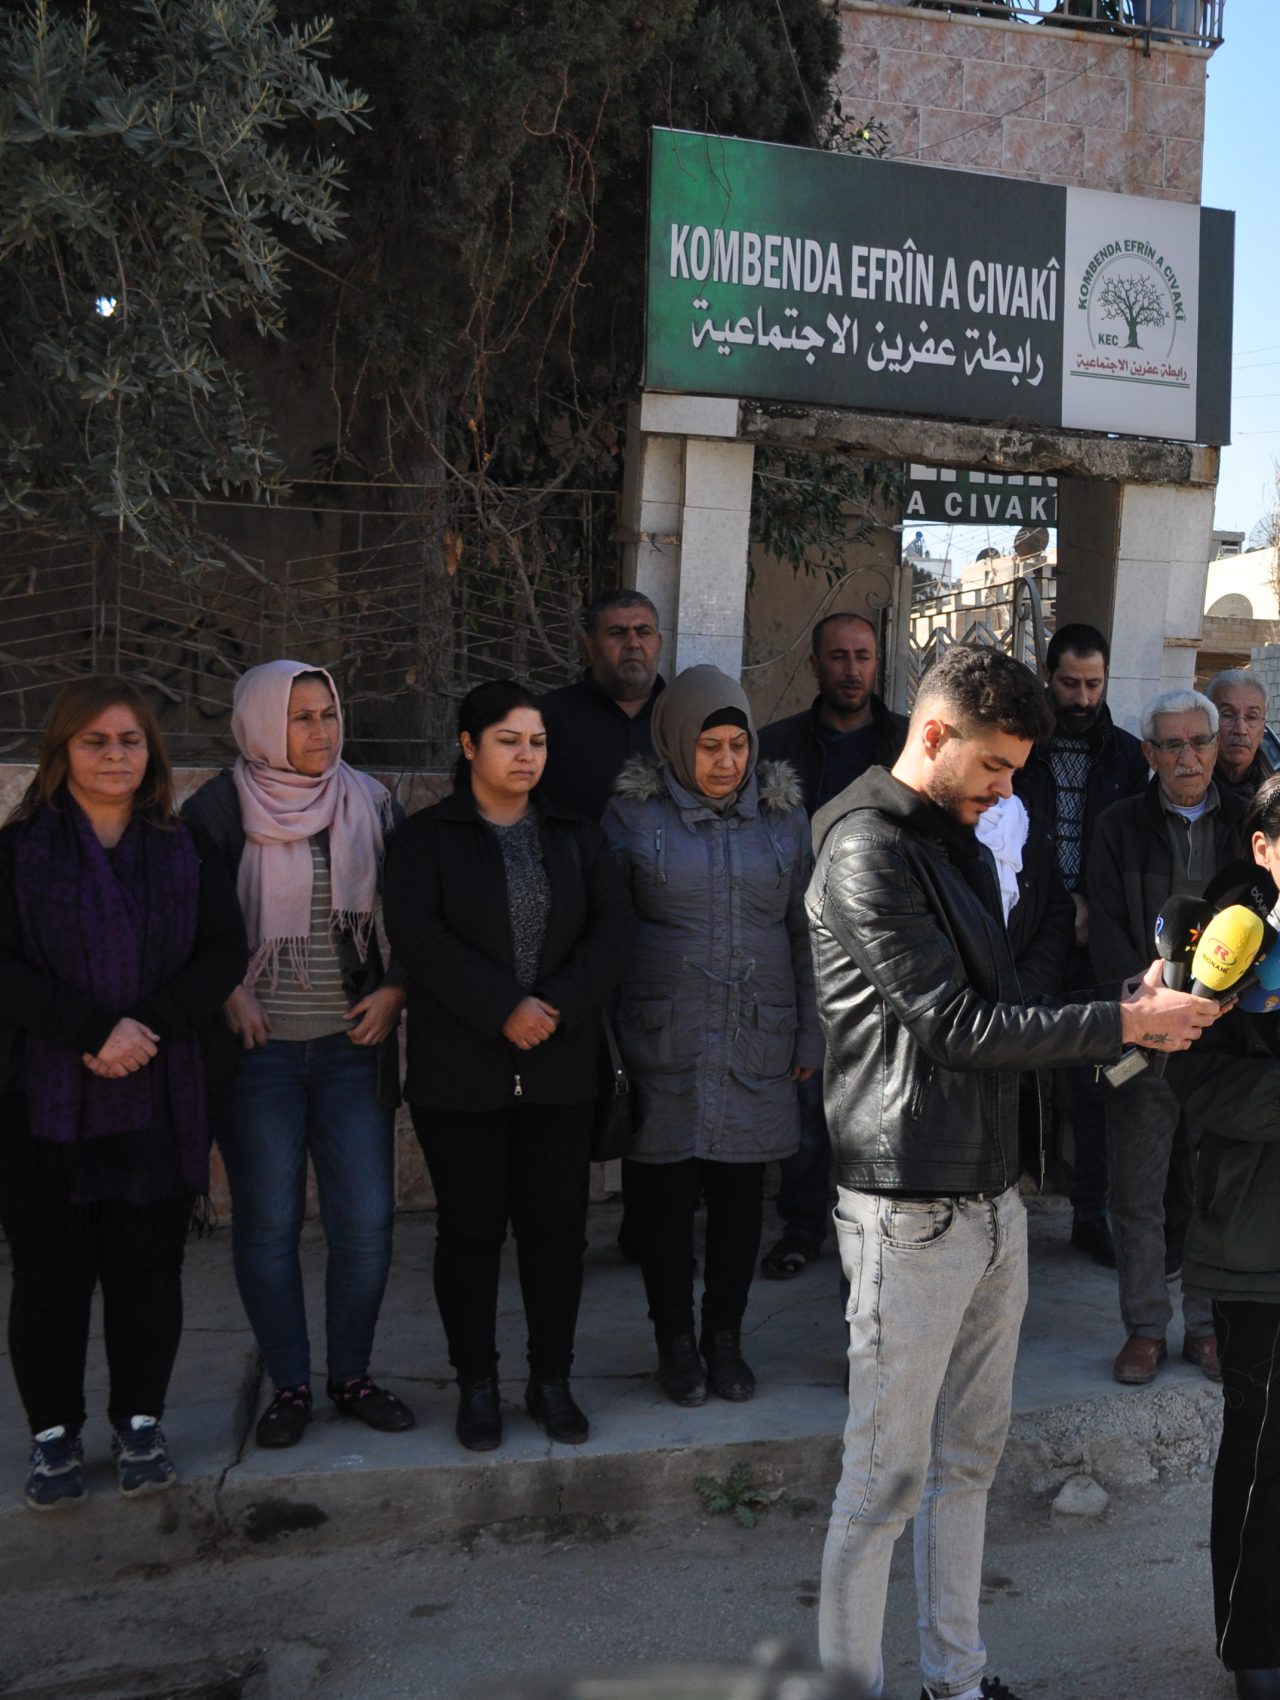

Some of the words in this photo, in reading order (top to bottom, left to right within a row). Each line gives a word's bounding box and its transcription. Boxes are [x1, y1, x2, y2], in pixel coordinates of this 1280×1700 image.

[669, 223, 843, 297] KOMBENDA
[851, 237, 935, 306] EFRÎN
[940, 258, 960, 311] A
[967, 256, 1060, 322] CIVAKÎ
[1078, 241, 1122, 310] KOMBENDA
[1124, 240, 1156, 261] EFRÎN
[1156, 255, 1165, 268] A
[1163, 266, 1187, 322] CIVAKÎ
[691, 298, 858, 365] الاجتماعية
[867, 319, 956, 374] عفرين
[964, 328, 1044, 386] رابطة
[1098, 333, 1119, 347] KEC
[1130, 358, 1159, 376] عفرين
[1161, 362, 1187, 381] رابطة
[906, 490, 926, 515] A
